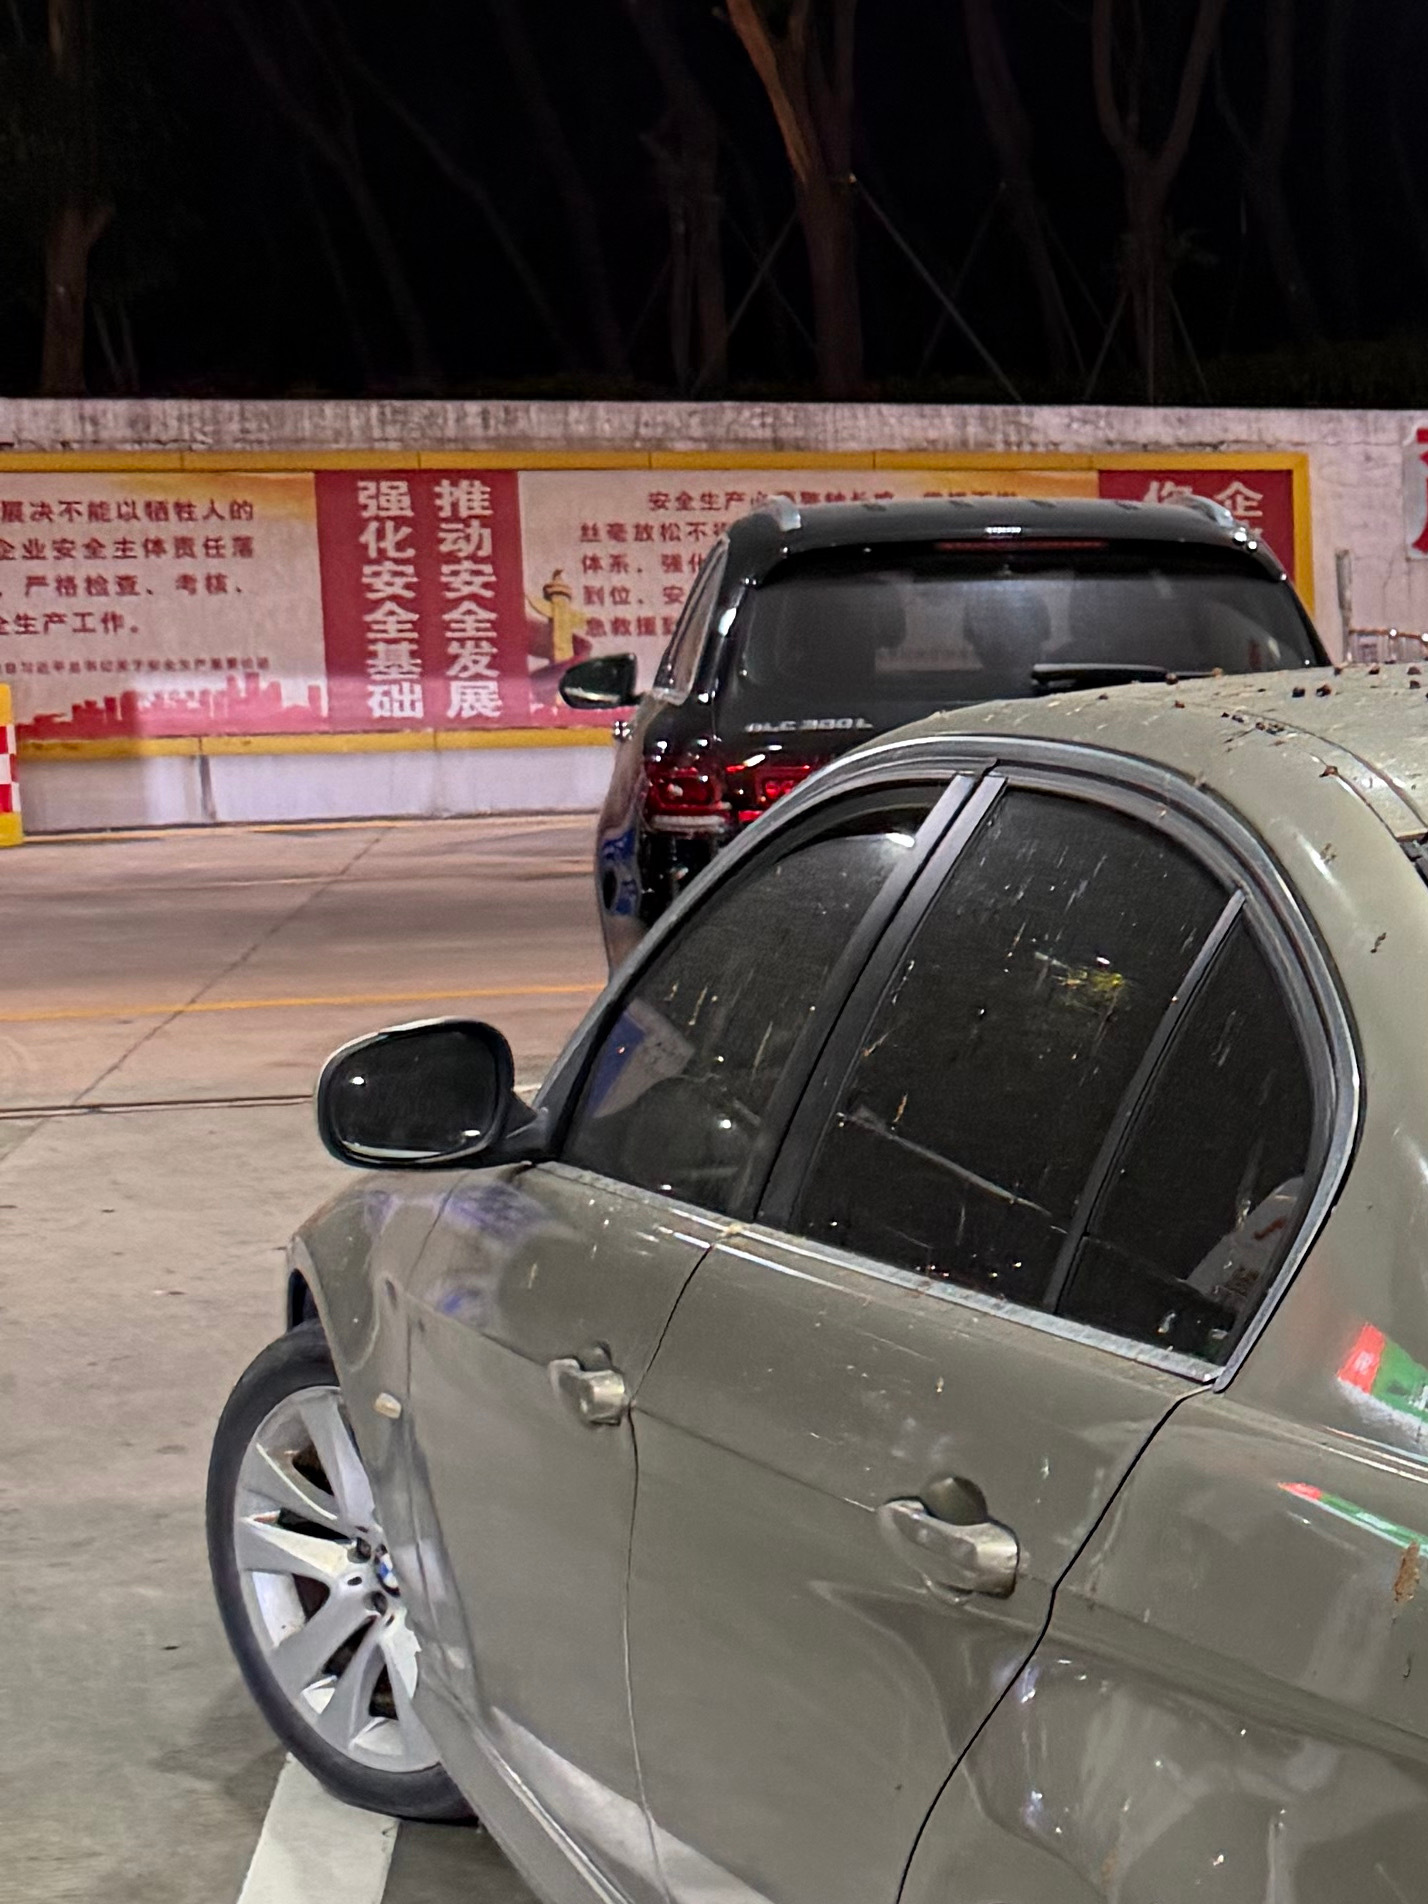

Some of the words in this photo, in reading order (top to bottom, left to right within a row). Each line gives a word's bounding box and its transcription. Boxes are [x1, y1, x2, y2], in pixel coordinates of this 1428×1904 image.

[358, 480, 424, 719] 强化安全基础
[433, 478, 503, 719] 推动安全发展
